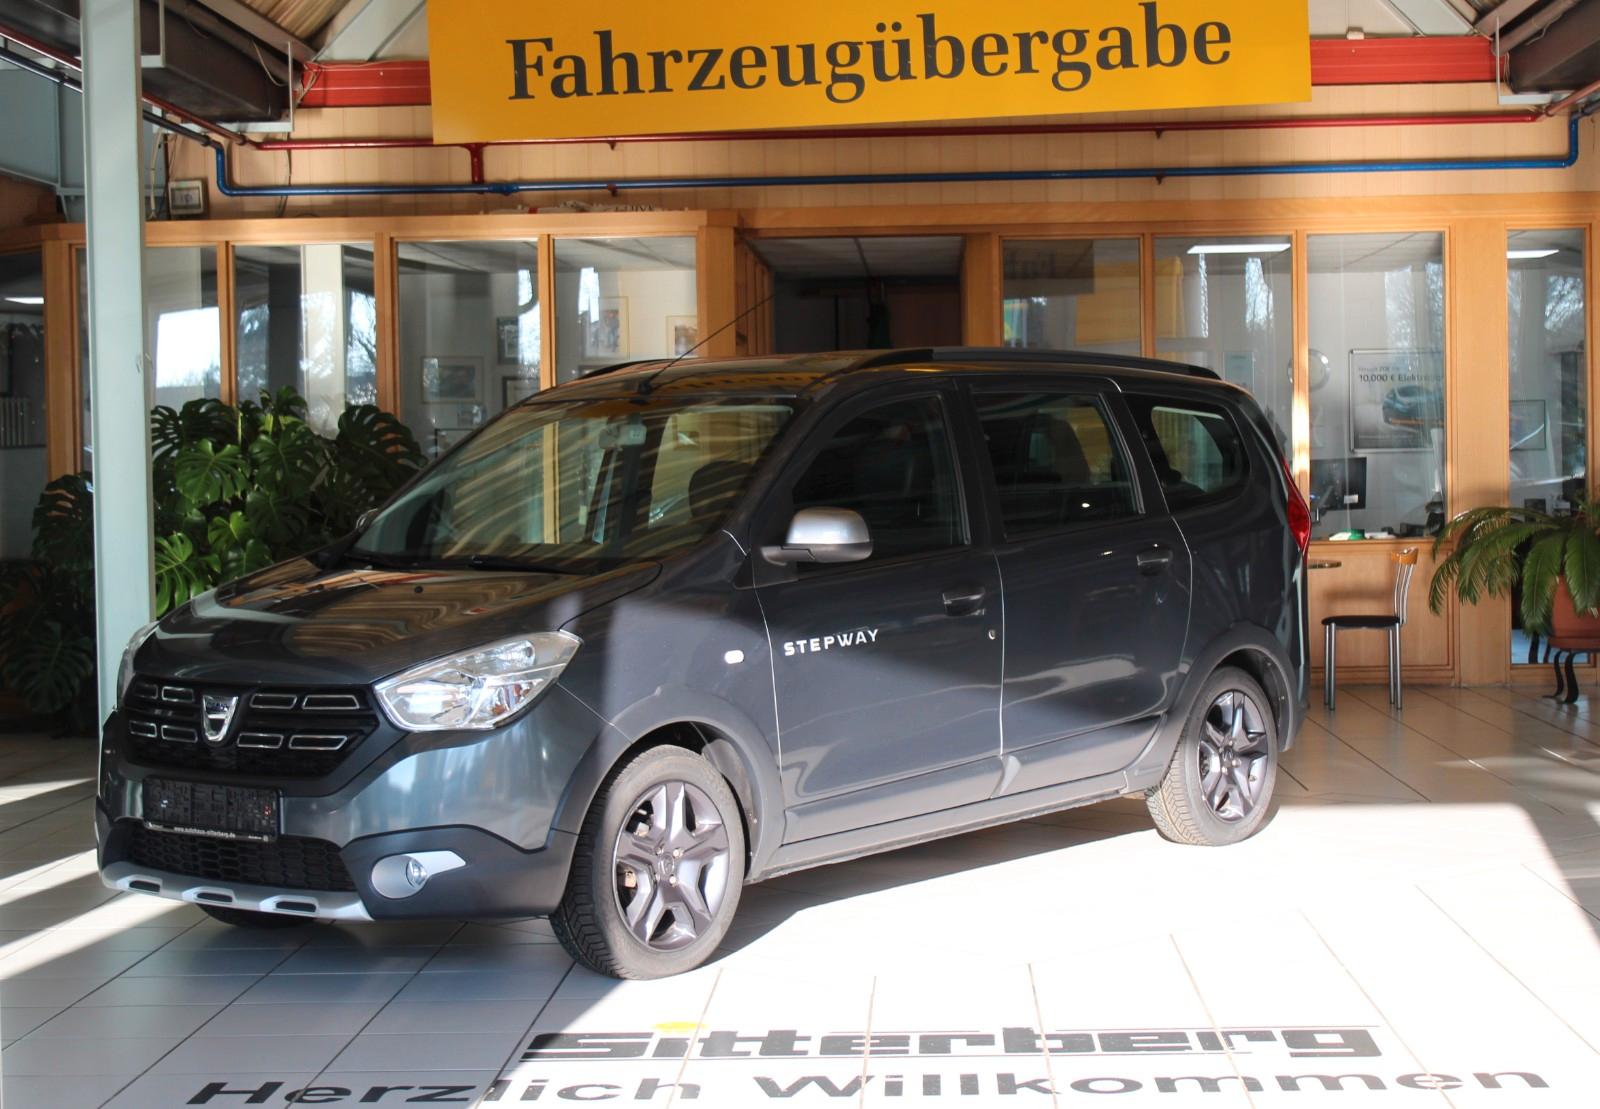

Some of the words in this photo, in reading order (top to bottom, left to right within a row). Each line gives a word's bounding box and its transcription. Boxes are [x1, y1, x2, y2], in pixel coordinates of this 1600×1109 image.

[506, 1, 1233, 104] Fahrzeugübergabe
[783, 628, 879, 657] STEPWAY
[185, 1077, 702, 1105] Herzlich
[752, 1071, 1551, 1098] Willkommen
